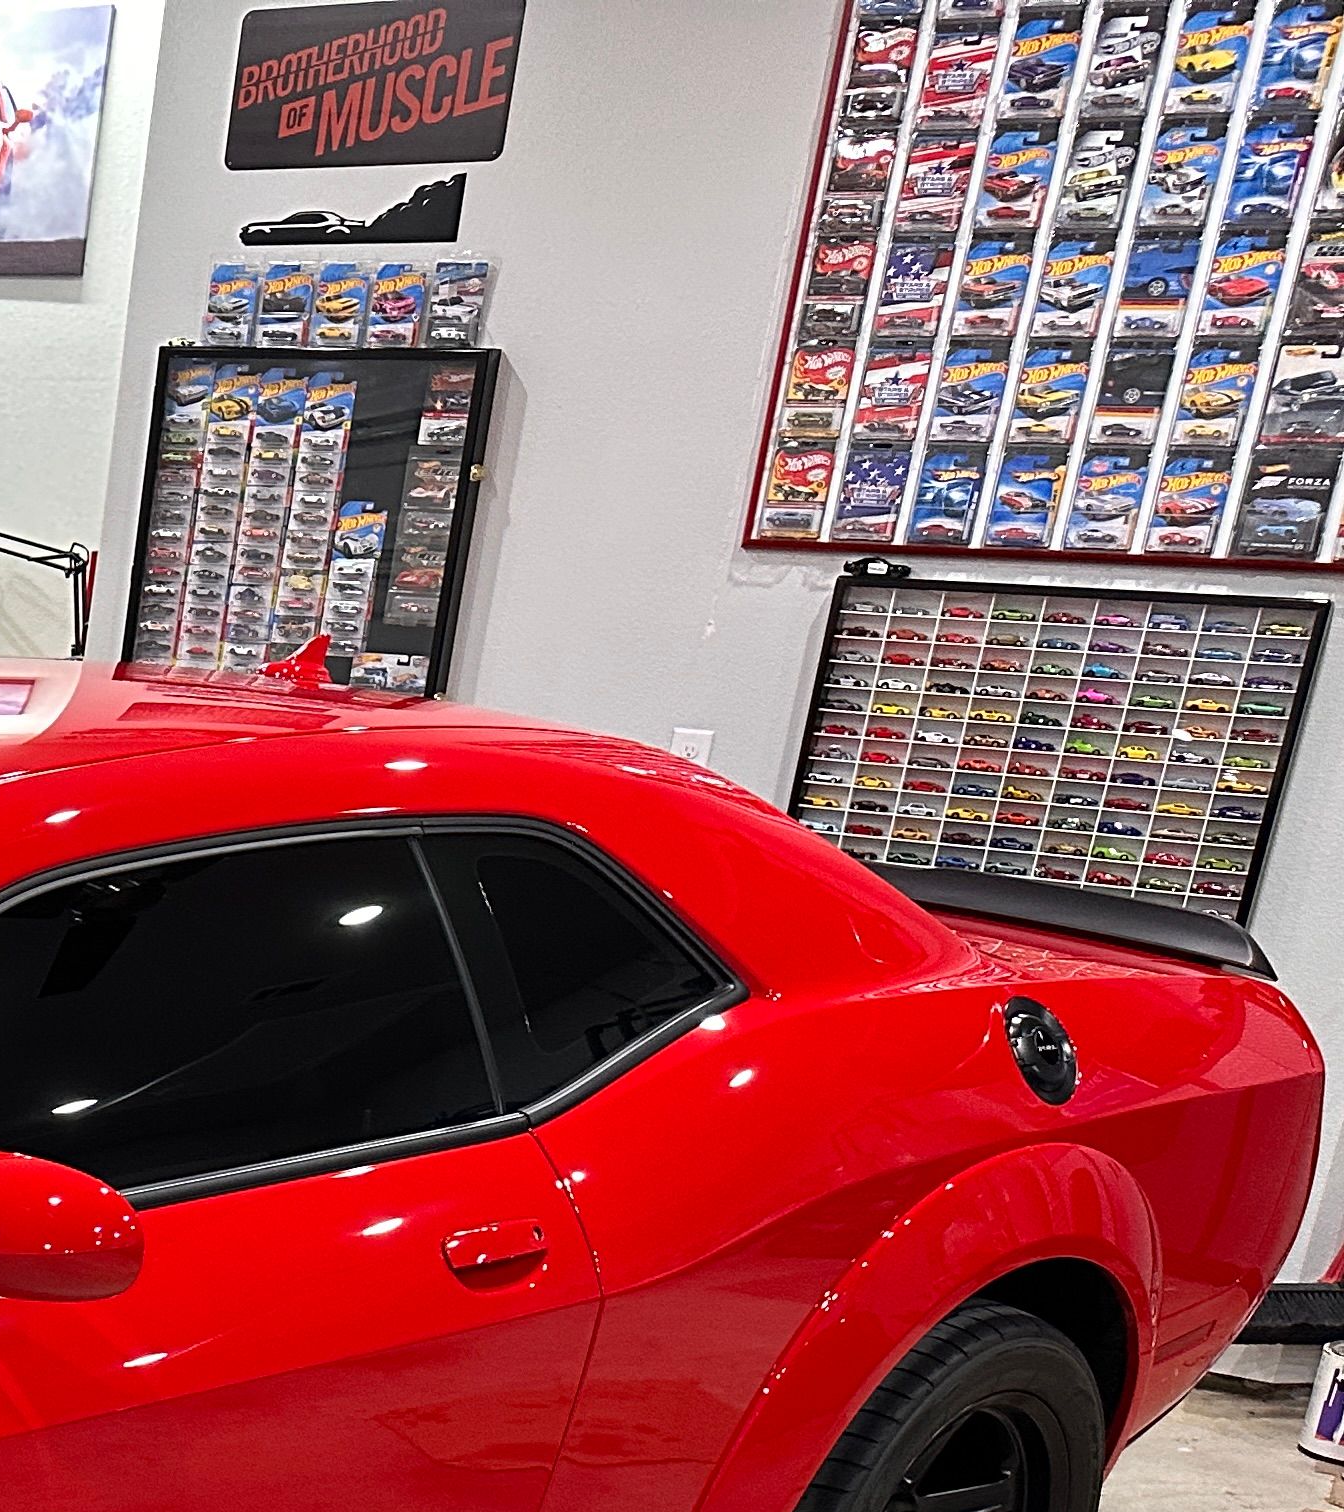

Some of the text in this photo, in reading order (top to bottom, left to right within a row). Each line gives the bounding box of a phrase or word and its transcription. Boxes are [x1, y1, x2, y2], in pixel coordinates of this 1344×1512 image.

[238, 7, 448, 110] BROTHERHOOD
[286, 36, 514, 157] OF MUSCLE
[1288, 477, 1331, 486] FORZA
